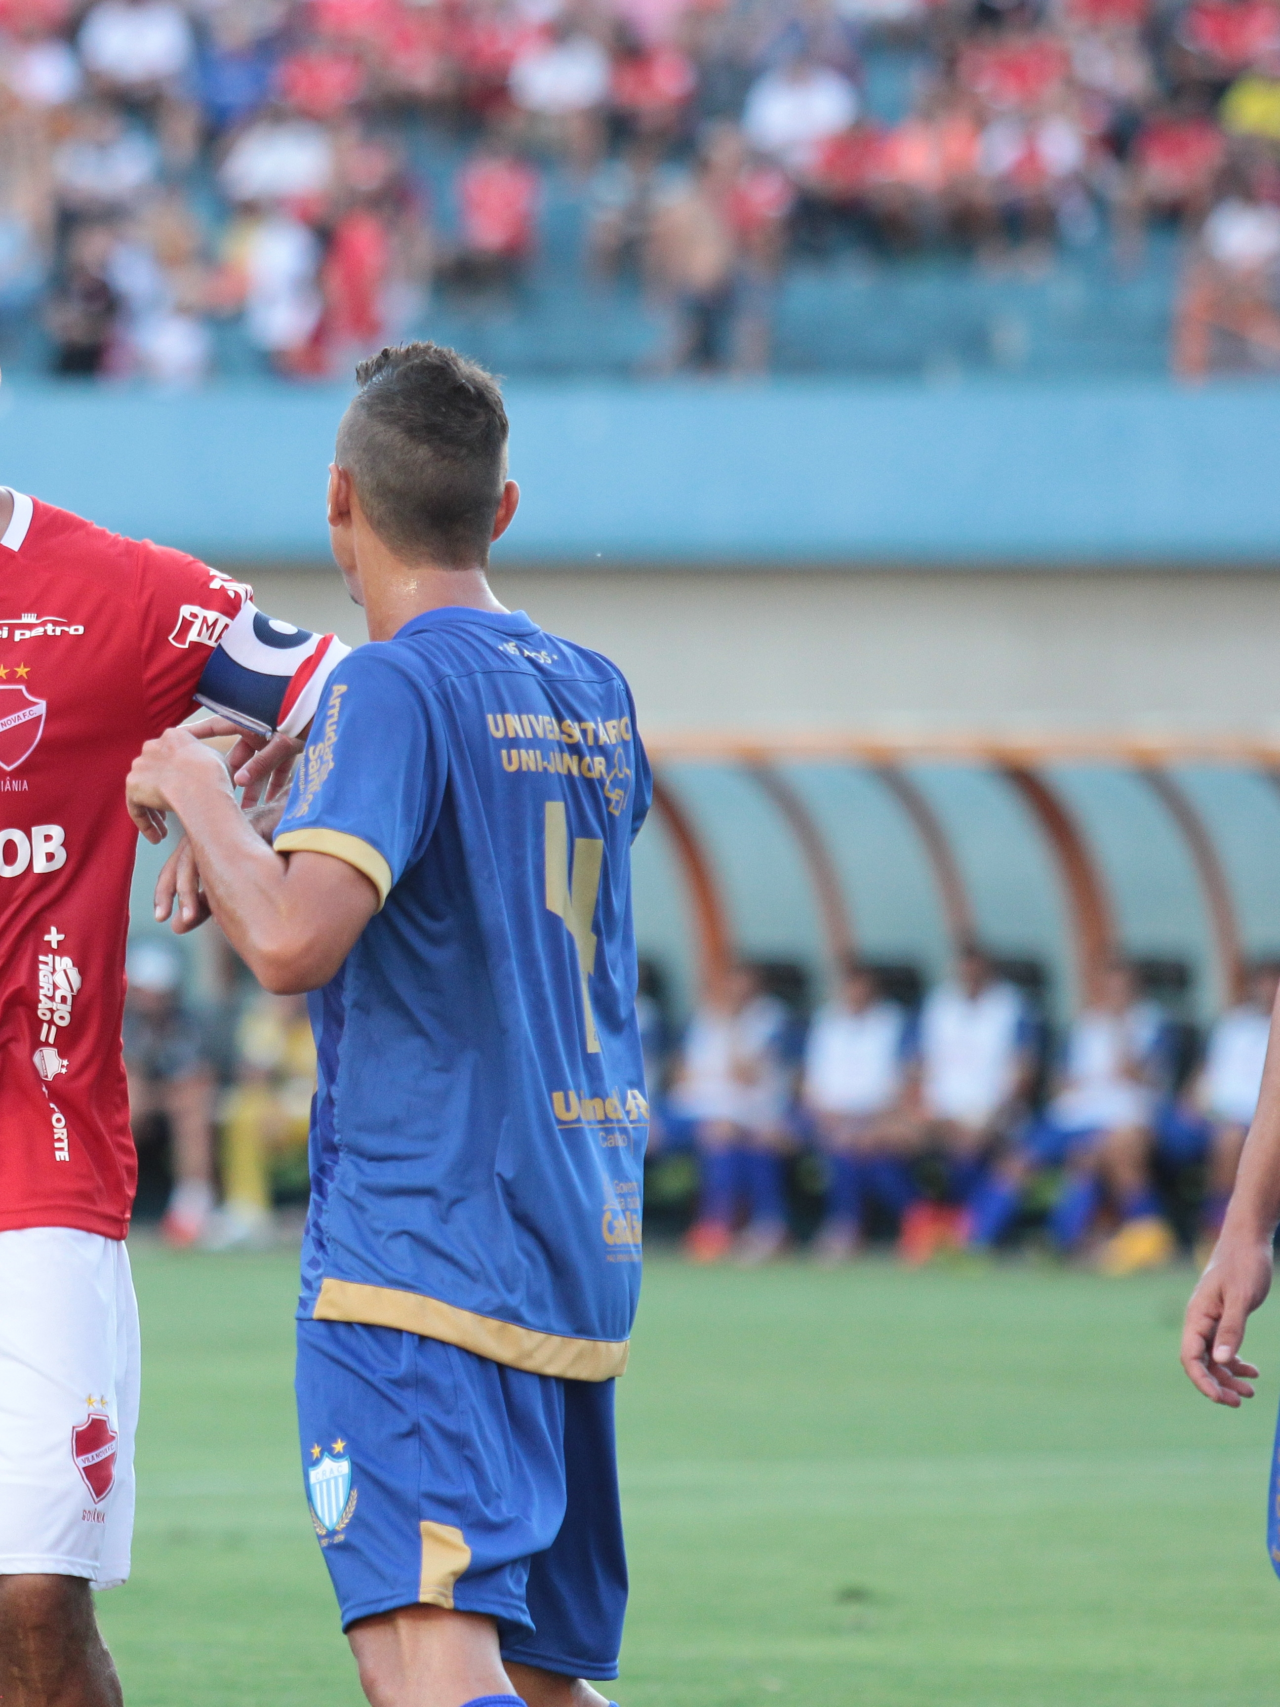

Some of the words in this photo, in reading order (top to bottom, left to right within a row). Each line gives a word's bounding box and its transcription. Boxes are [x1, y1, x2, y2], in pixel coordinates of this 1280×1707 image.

[14, 623, 85, 642] petro
[0, 714, 23, 729] NOVA
[22, 709, 37, 720] F.C.
[37, 954, 54, 1021] TIGRÃO
